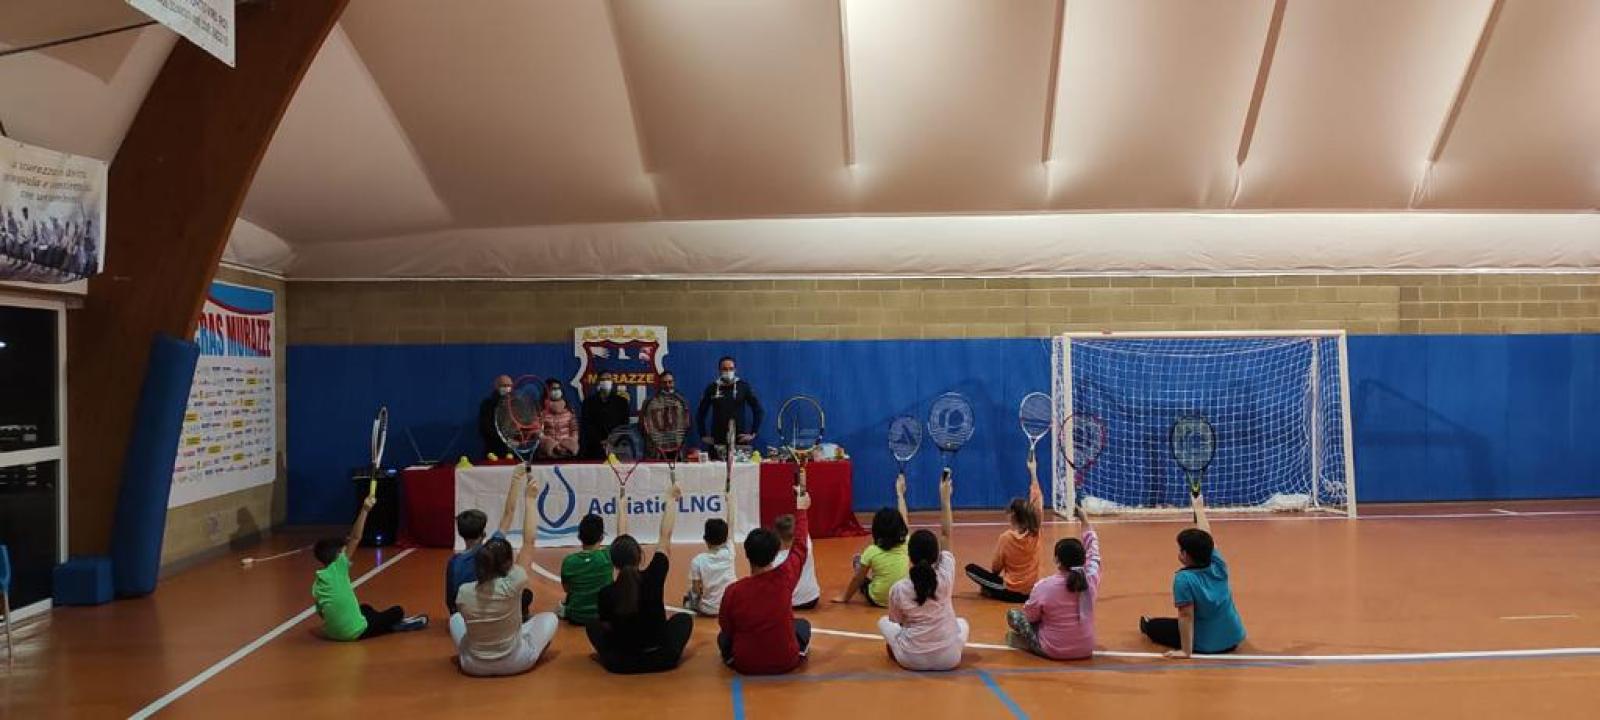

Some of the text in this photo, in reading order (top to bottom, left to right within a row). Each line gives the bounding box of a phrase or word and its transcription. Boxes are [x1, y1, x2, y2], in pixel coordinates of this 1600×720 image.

[197, 312, 271, 356] RAS MURAZZE
[587, 373, 656, 384] MRAZZE
[589, 494, 722, 514] Adiati LNG
